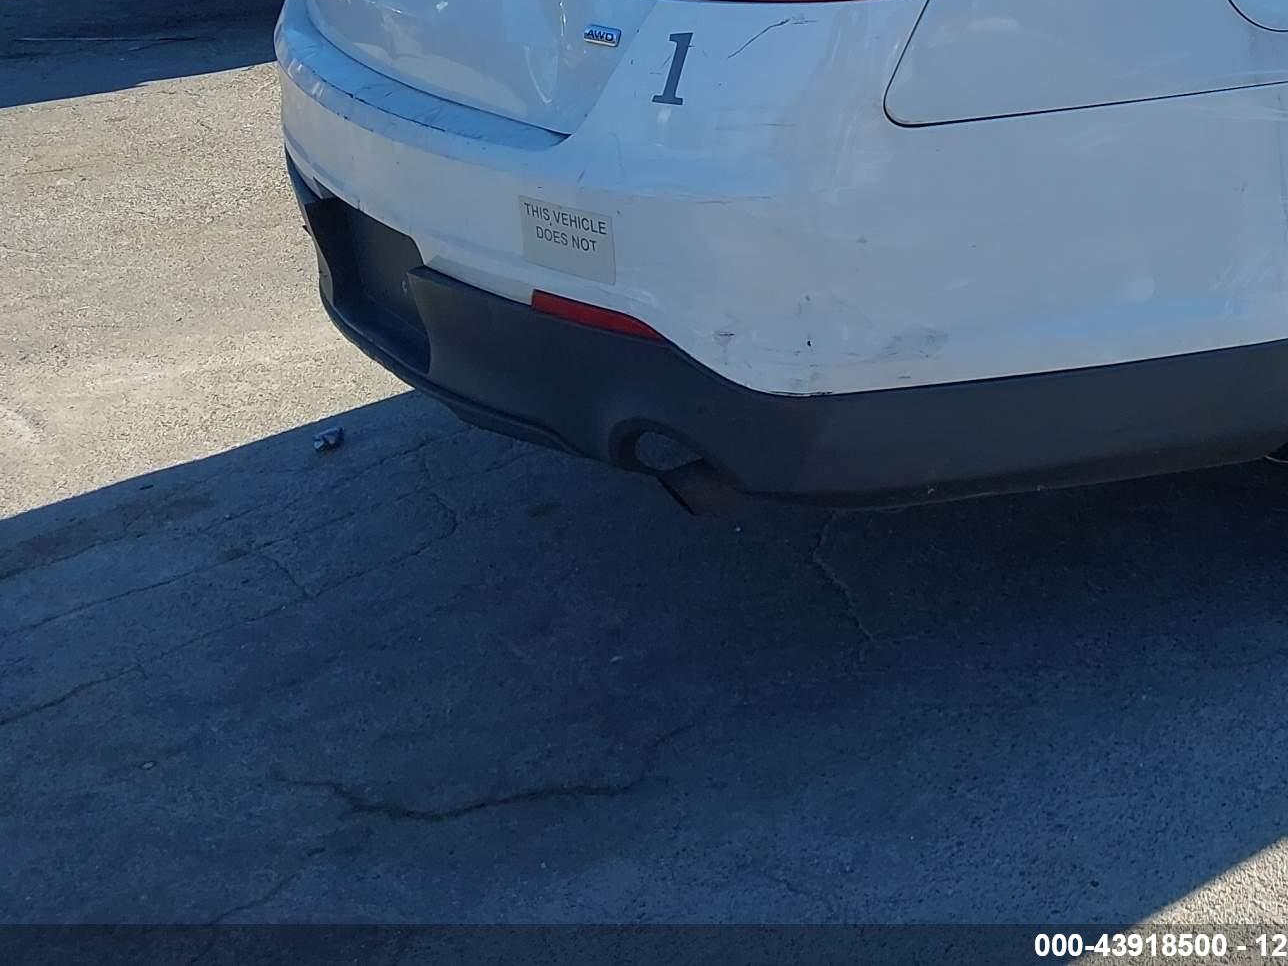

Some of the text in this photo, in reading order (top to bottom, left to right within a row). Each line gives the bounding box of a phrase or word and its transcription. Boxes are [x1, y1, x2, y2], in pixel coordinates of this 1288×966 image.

[586, 29, 614, 41] AWD
[652, 32, 694, 106] 1
[523, 202, 608, 235] THIS VEHICLE
[536, 225, 598, 251] DOES NOT
